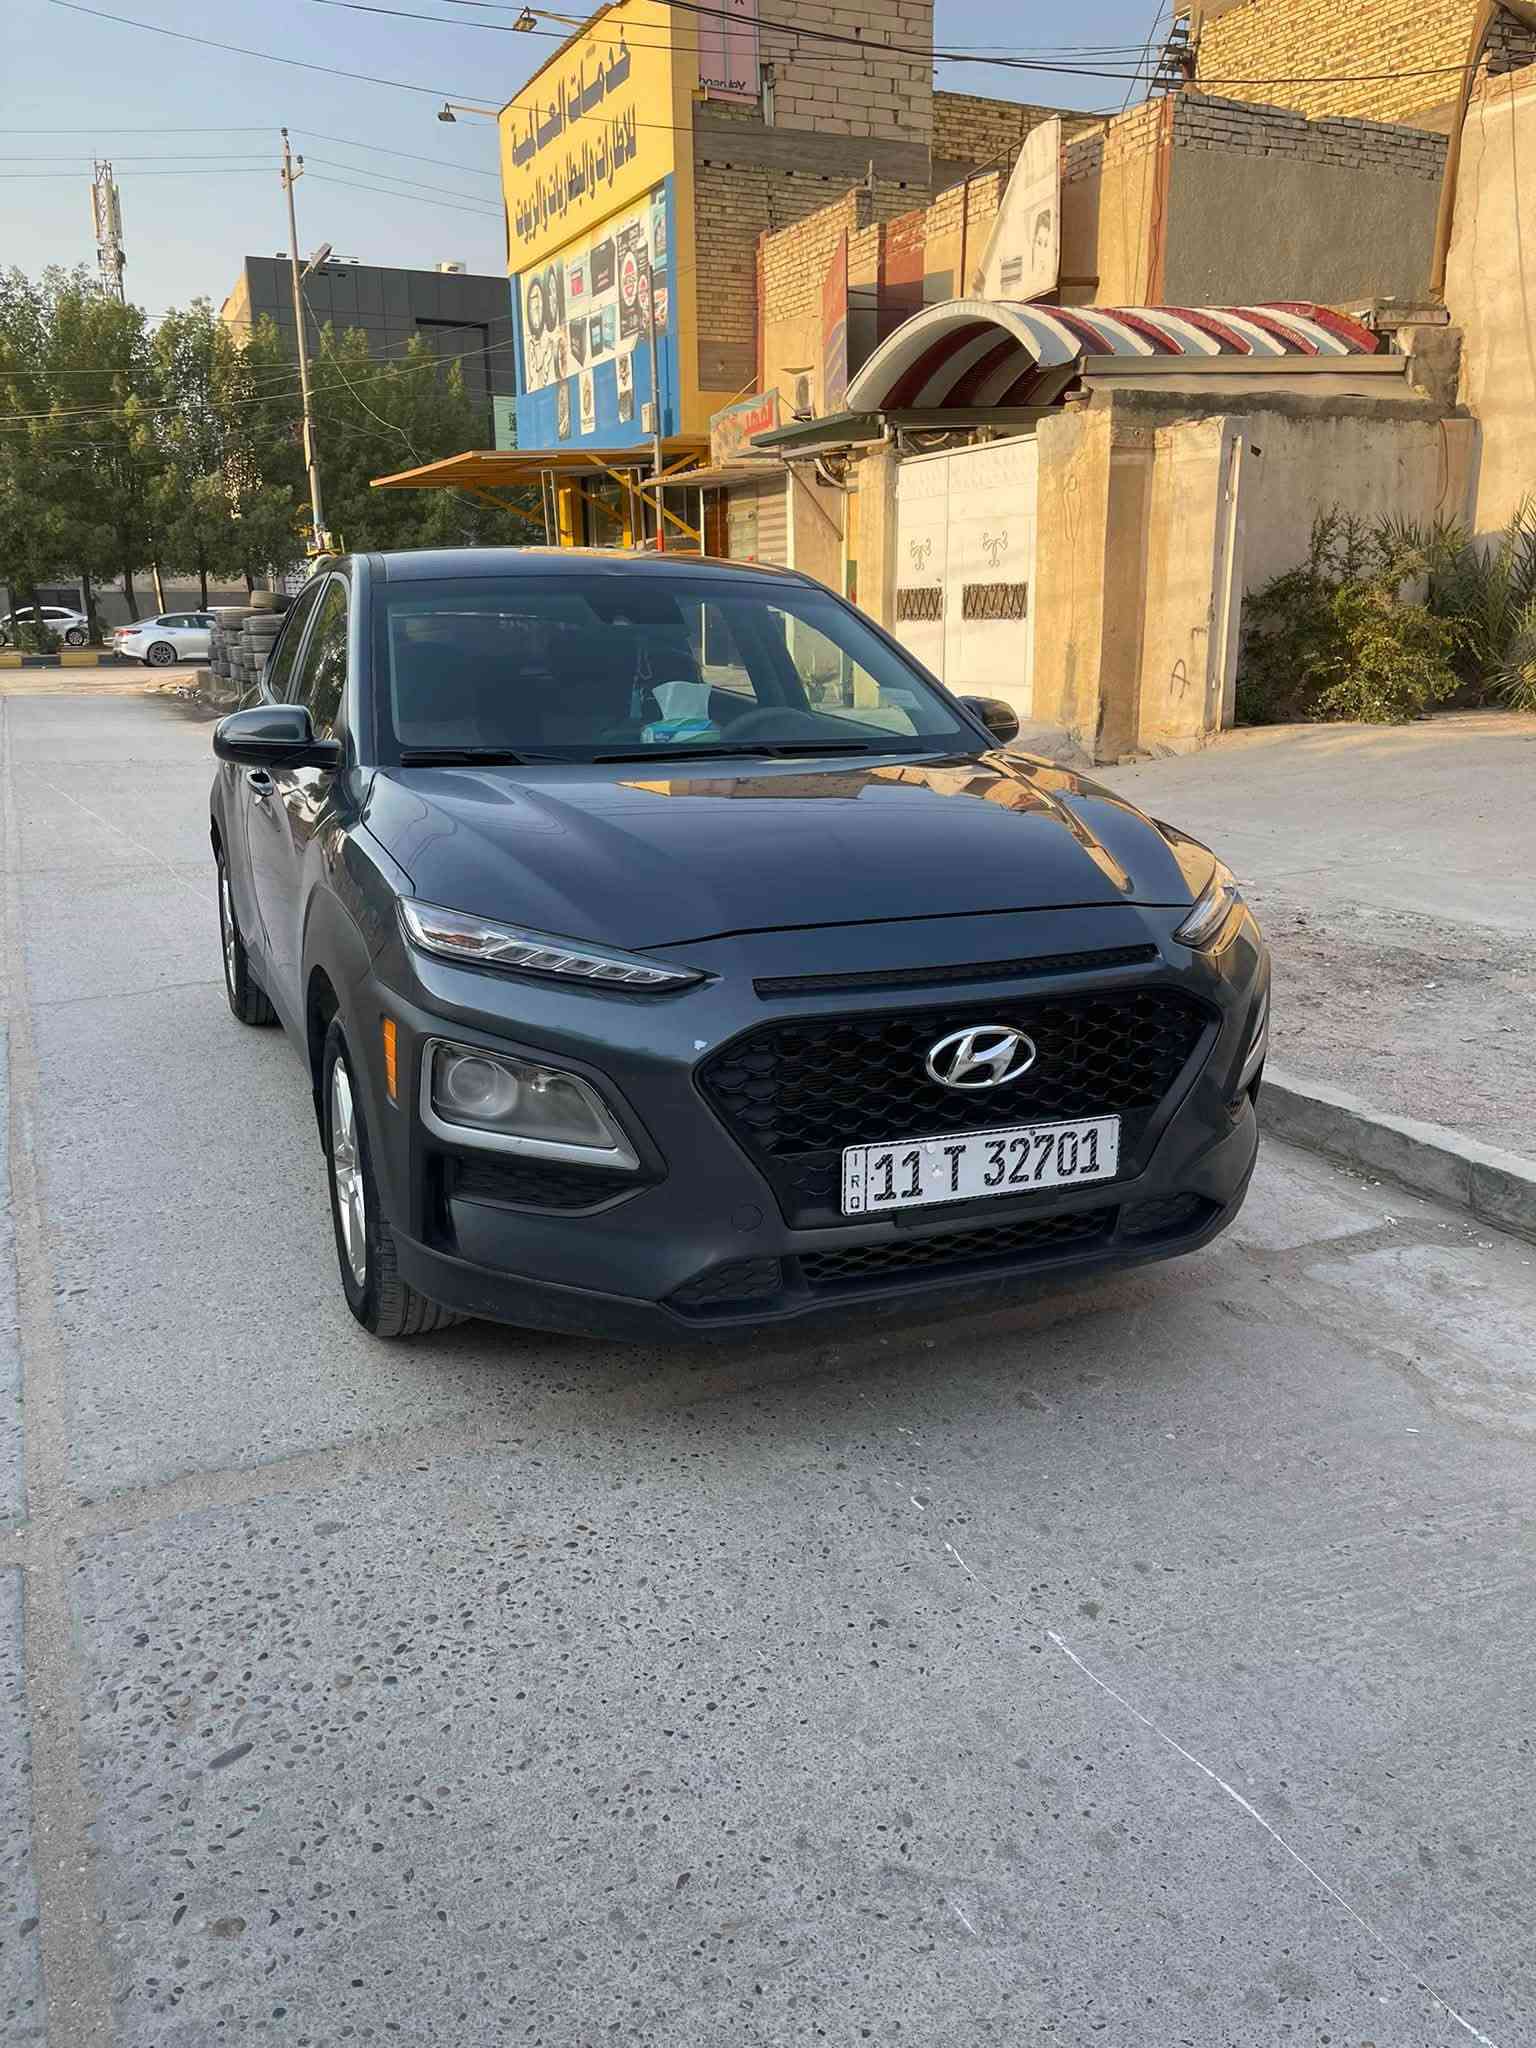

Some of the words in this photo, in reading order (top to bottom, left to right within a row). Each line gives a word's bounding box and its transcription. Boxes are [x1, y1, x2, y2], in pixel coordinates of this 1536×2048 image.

[874, 1150, 923, 1201] 11
[944, 1144, 966, 1191] T
[983, 1128, 1100, 1187] 32701
